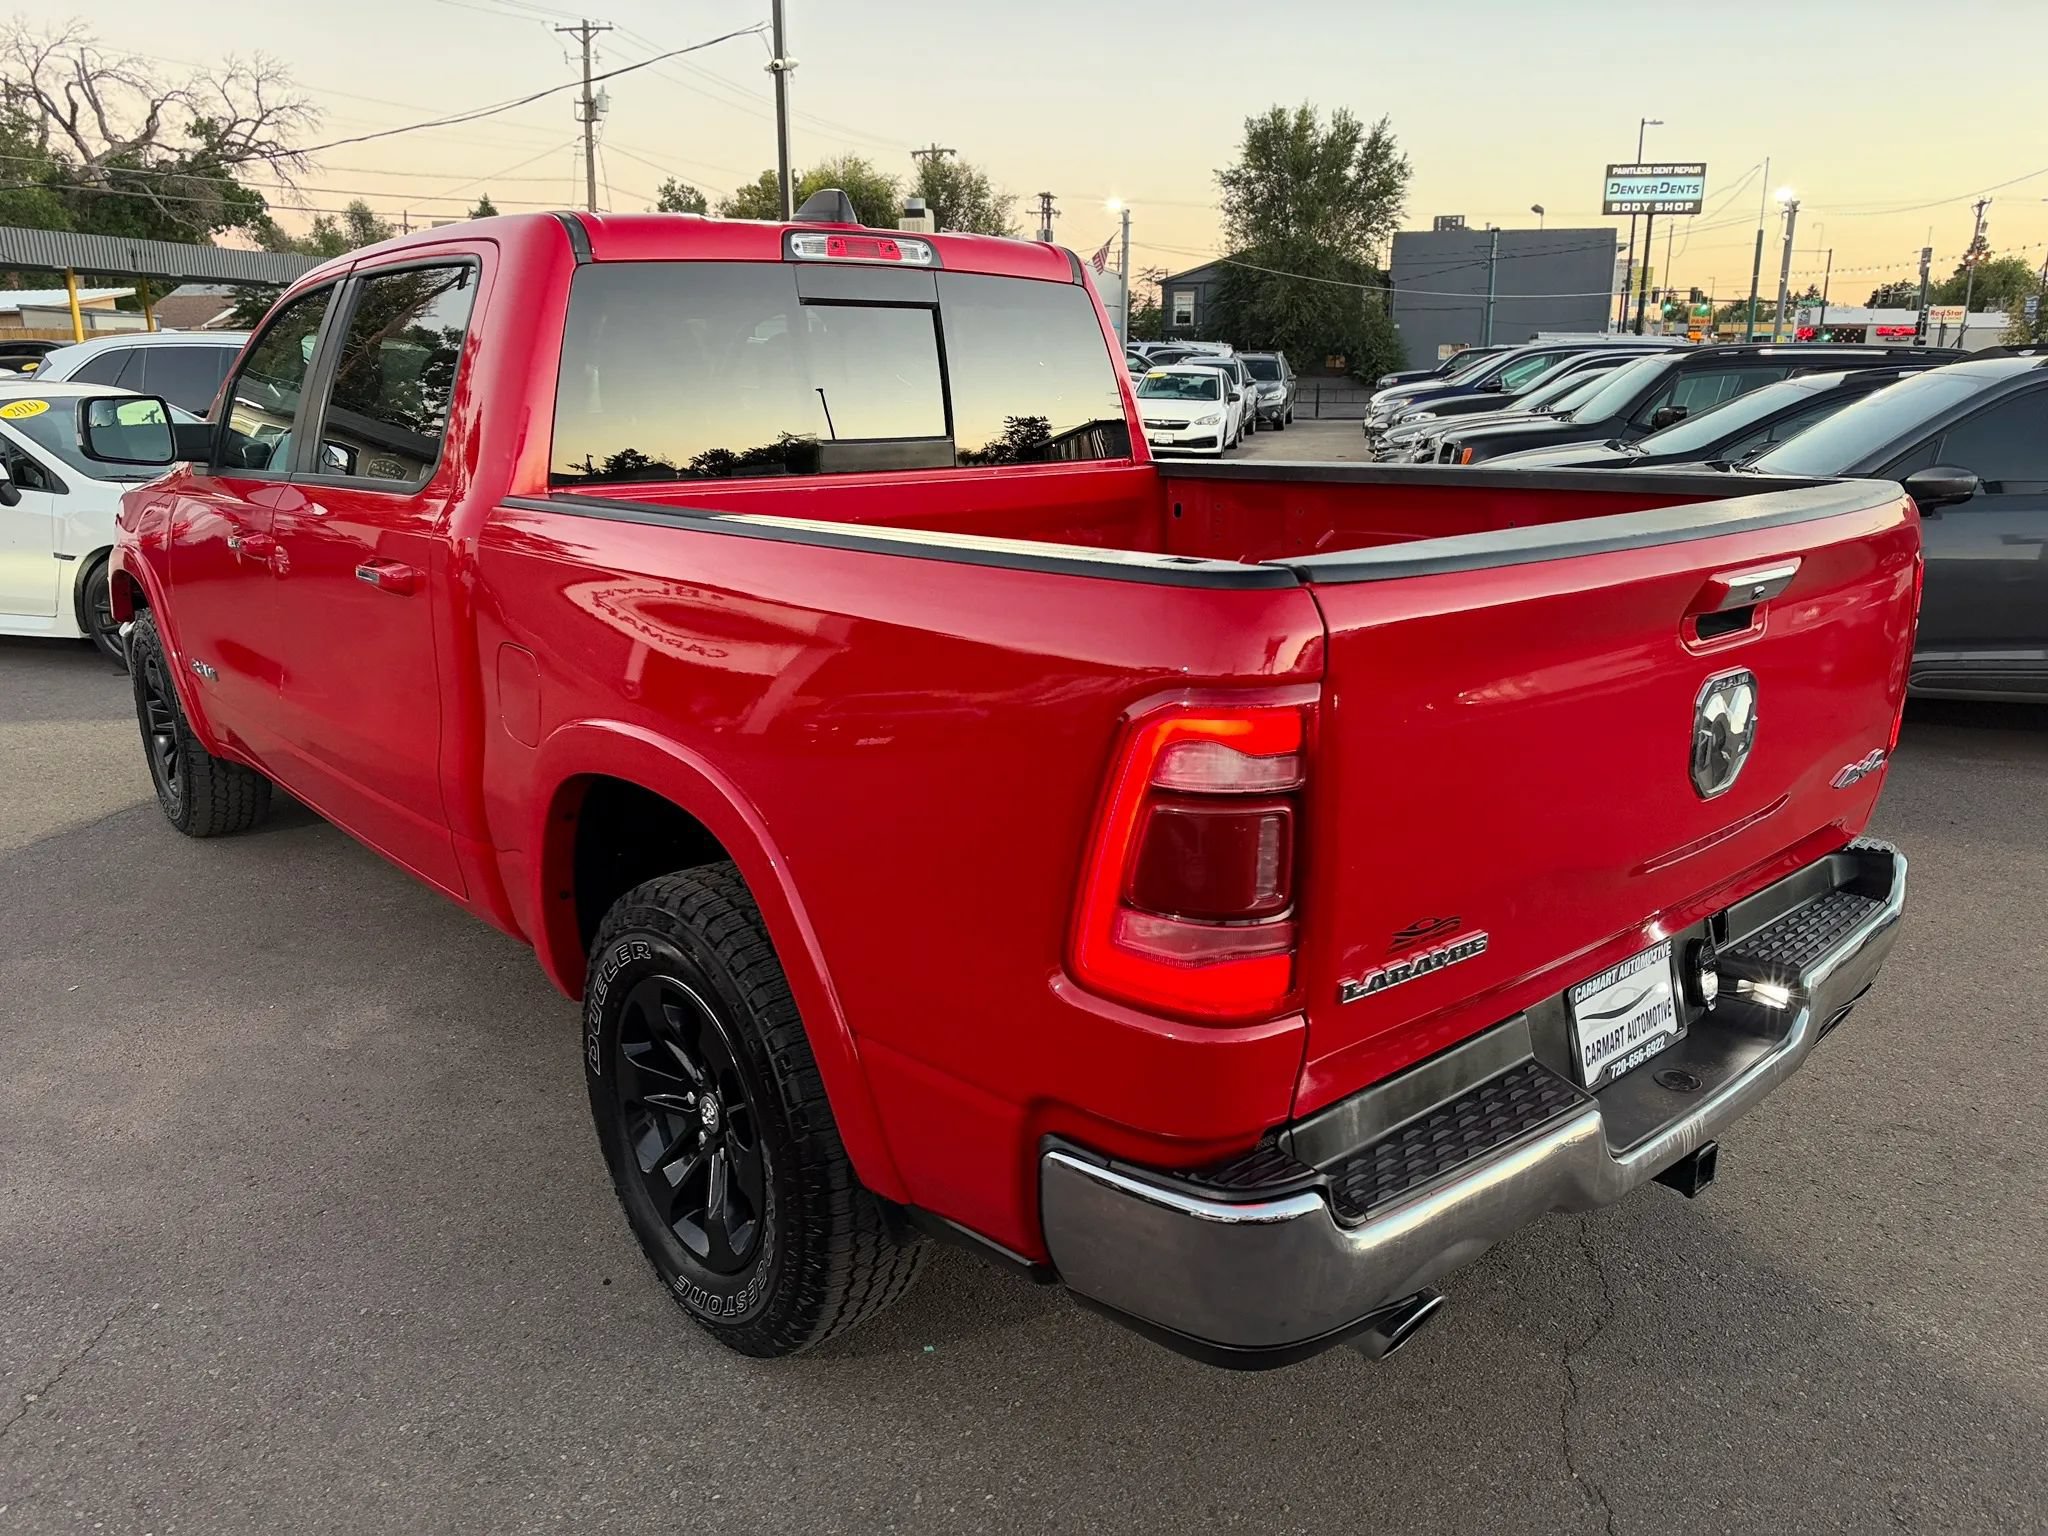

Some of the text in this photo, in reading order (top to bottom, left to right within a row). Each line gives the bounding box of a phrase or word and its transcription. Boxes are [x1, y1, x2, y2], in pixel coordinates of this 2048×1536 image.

[1612, 166, 1701, 175] PAINTLESS DENT REPAIR
[1612, 202, 1694, 212] BODY SHOP
[7, 401, 40, 417] 2019
[1713, 673, 1750, 693] RAM
[1340, 931, 1489, 1005] LARAMIE
[1575, 941, 1672, 1004] CARMART AUTOMOTIVE
[587, 940, 653, 1076] DUELER
[1585, 997, 1672, 1067] CARMART AUTOMOTIVE
[1611, 1035, 1665, 1079] 720-656-6922
